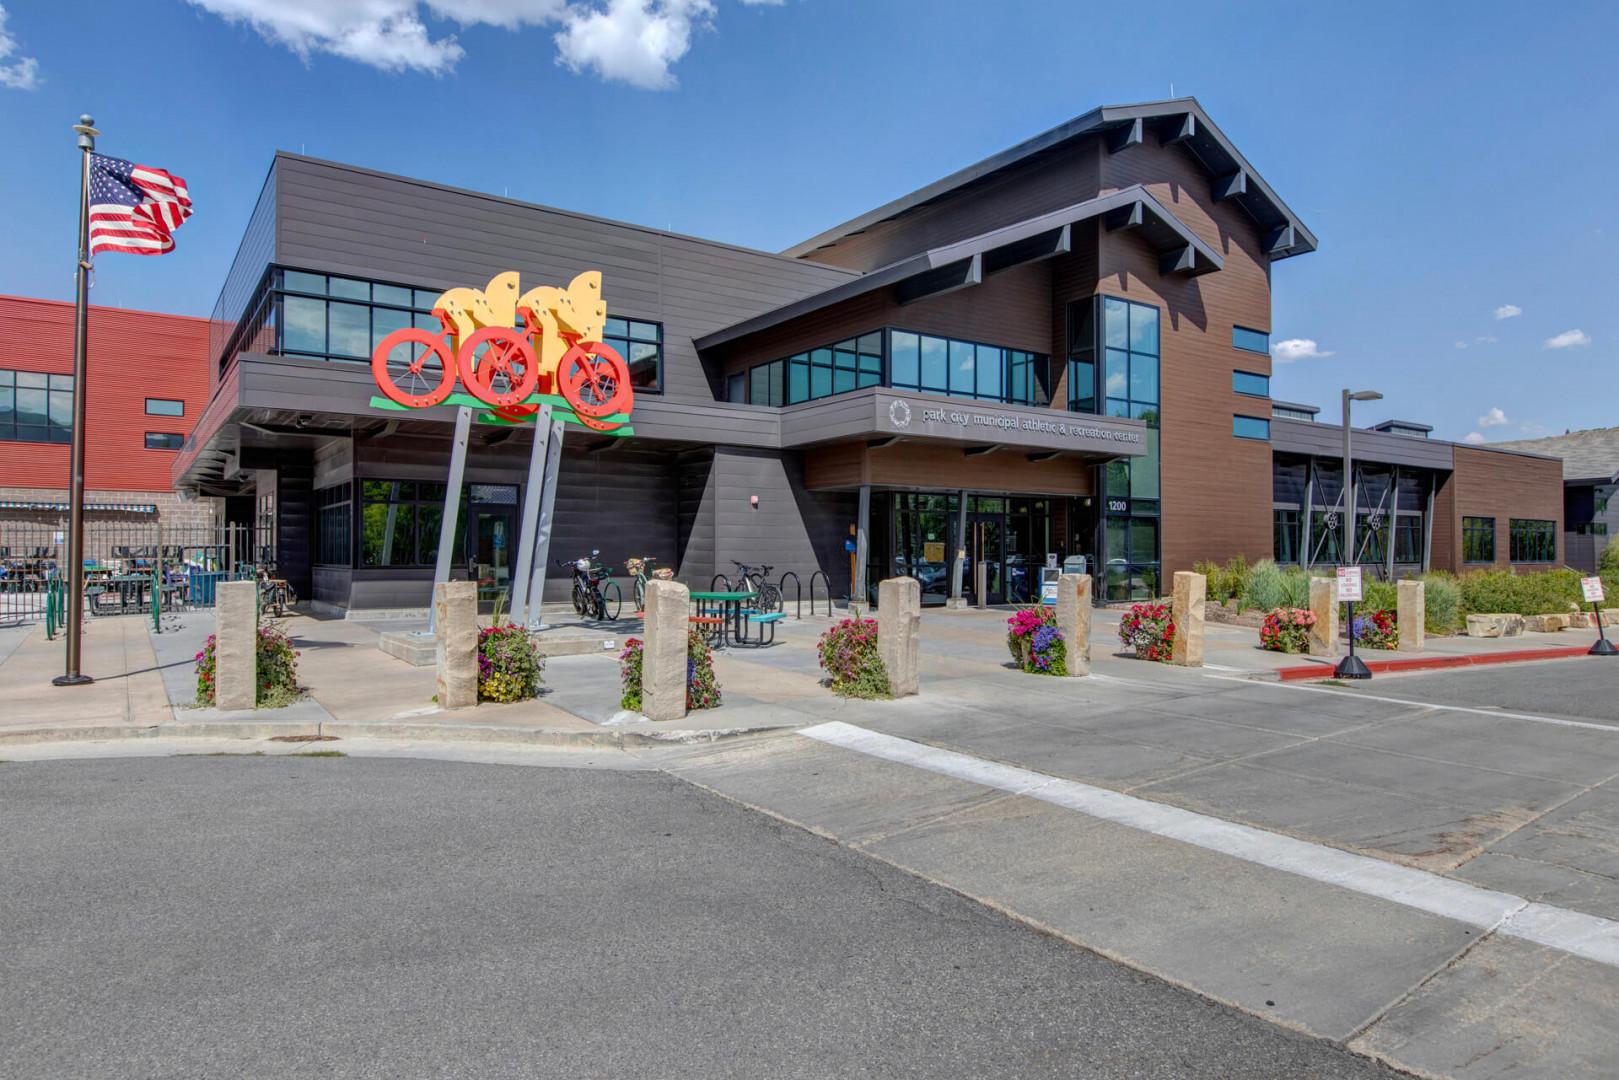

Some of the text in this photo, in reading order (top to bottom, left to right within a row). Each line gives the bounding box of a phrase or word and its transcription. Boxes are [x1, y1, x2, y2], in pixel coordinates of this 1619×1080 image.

[923, 408, 1139, 443] park city municipal athletic & recreation center
[1109, 501, 1127, 511] 1200
